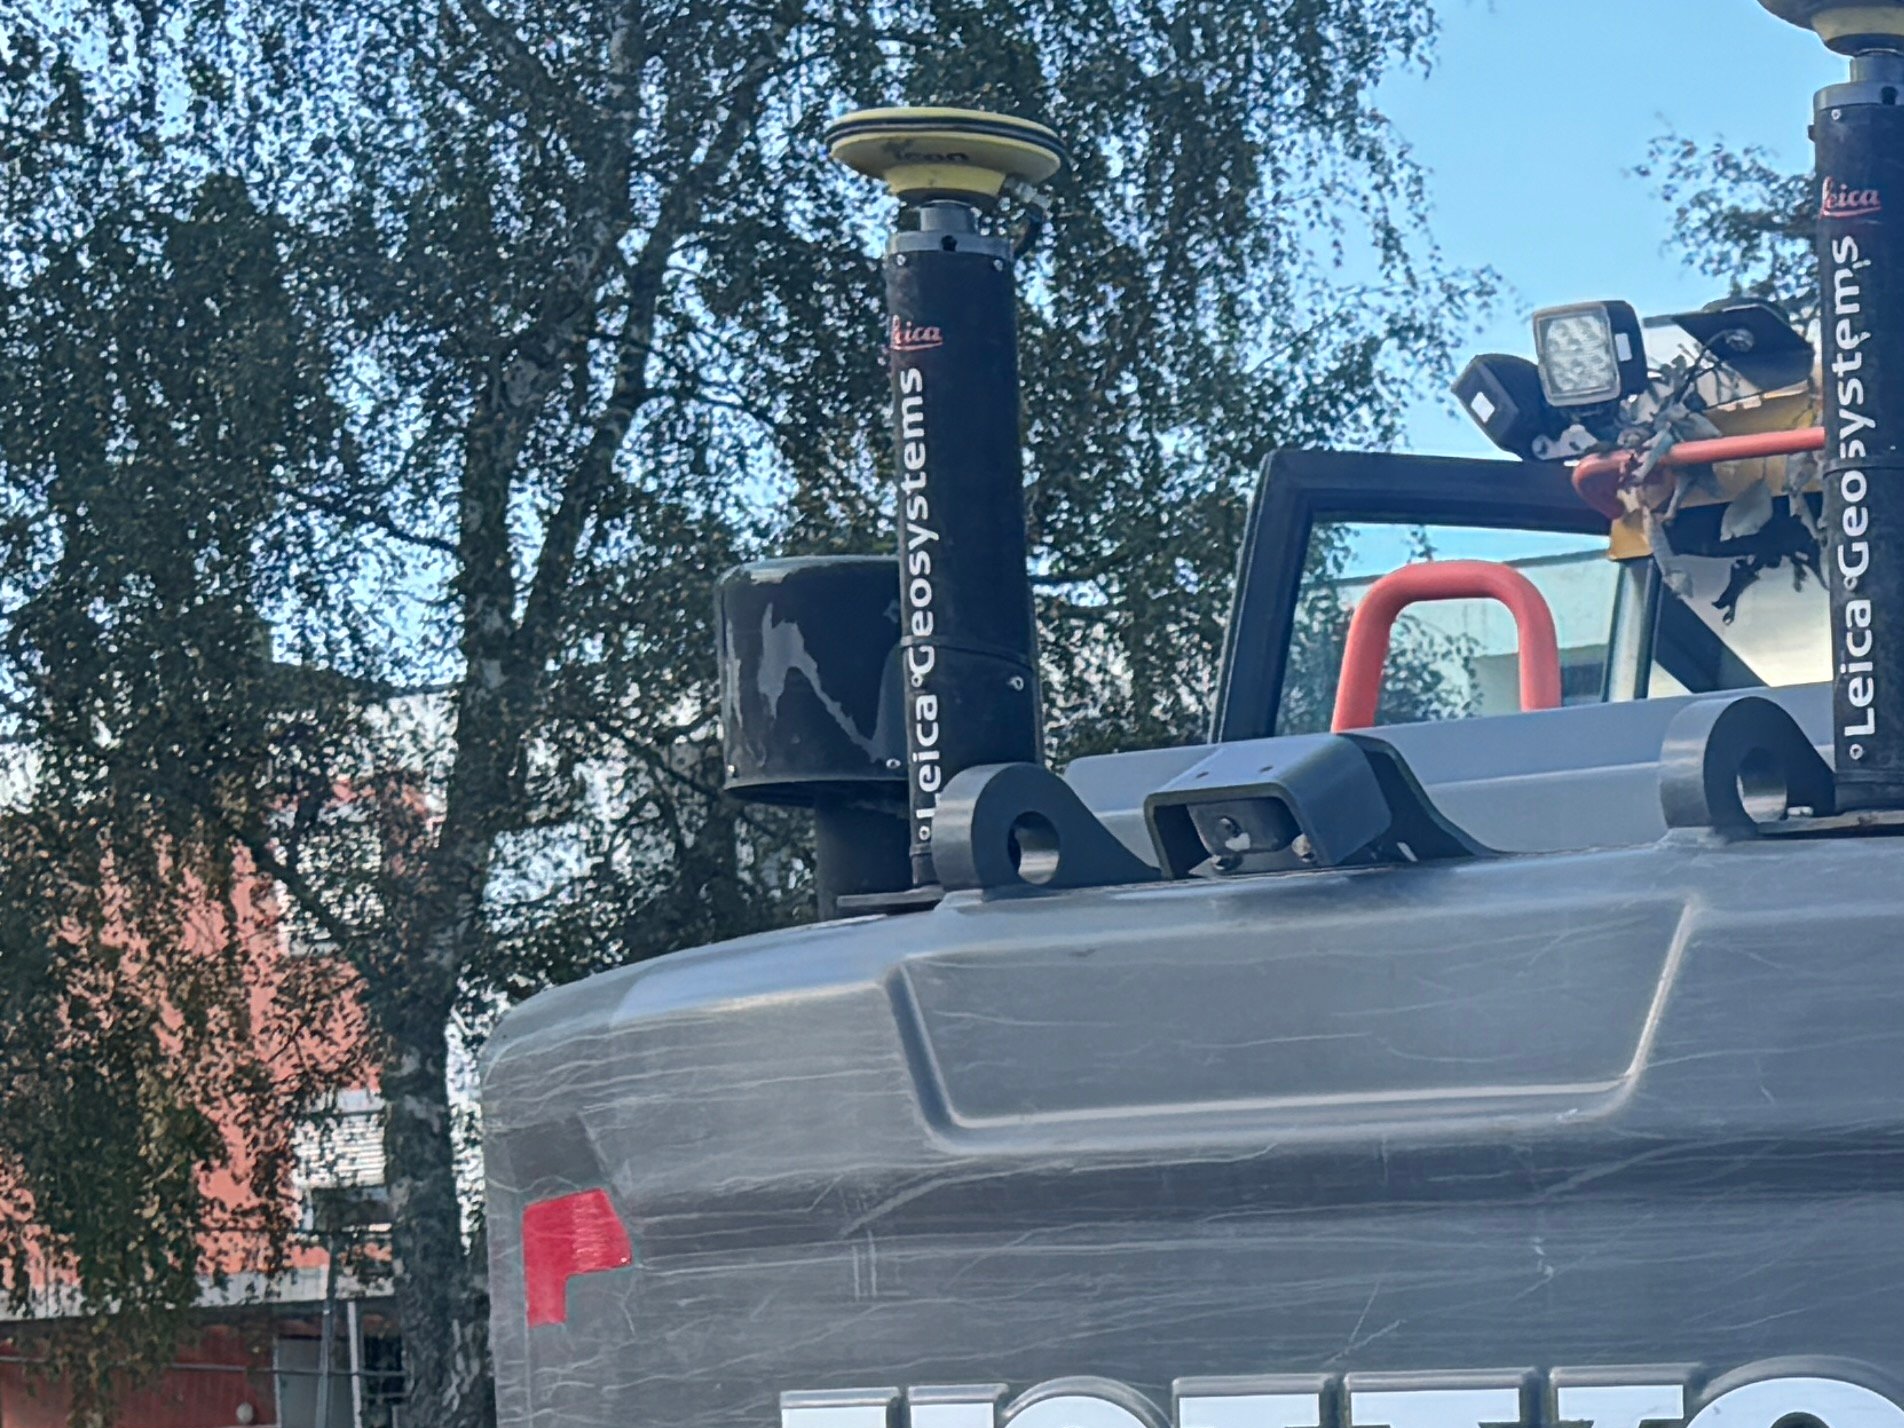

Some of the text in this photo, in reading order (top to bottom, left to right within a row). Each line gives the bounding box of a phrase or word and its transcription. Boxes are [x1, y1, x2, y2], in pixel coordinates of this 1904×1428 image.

[900, 367, 942, 819] Leica Geosystems
[1832, 235, 1876, 737] Leica Geosystems
